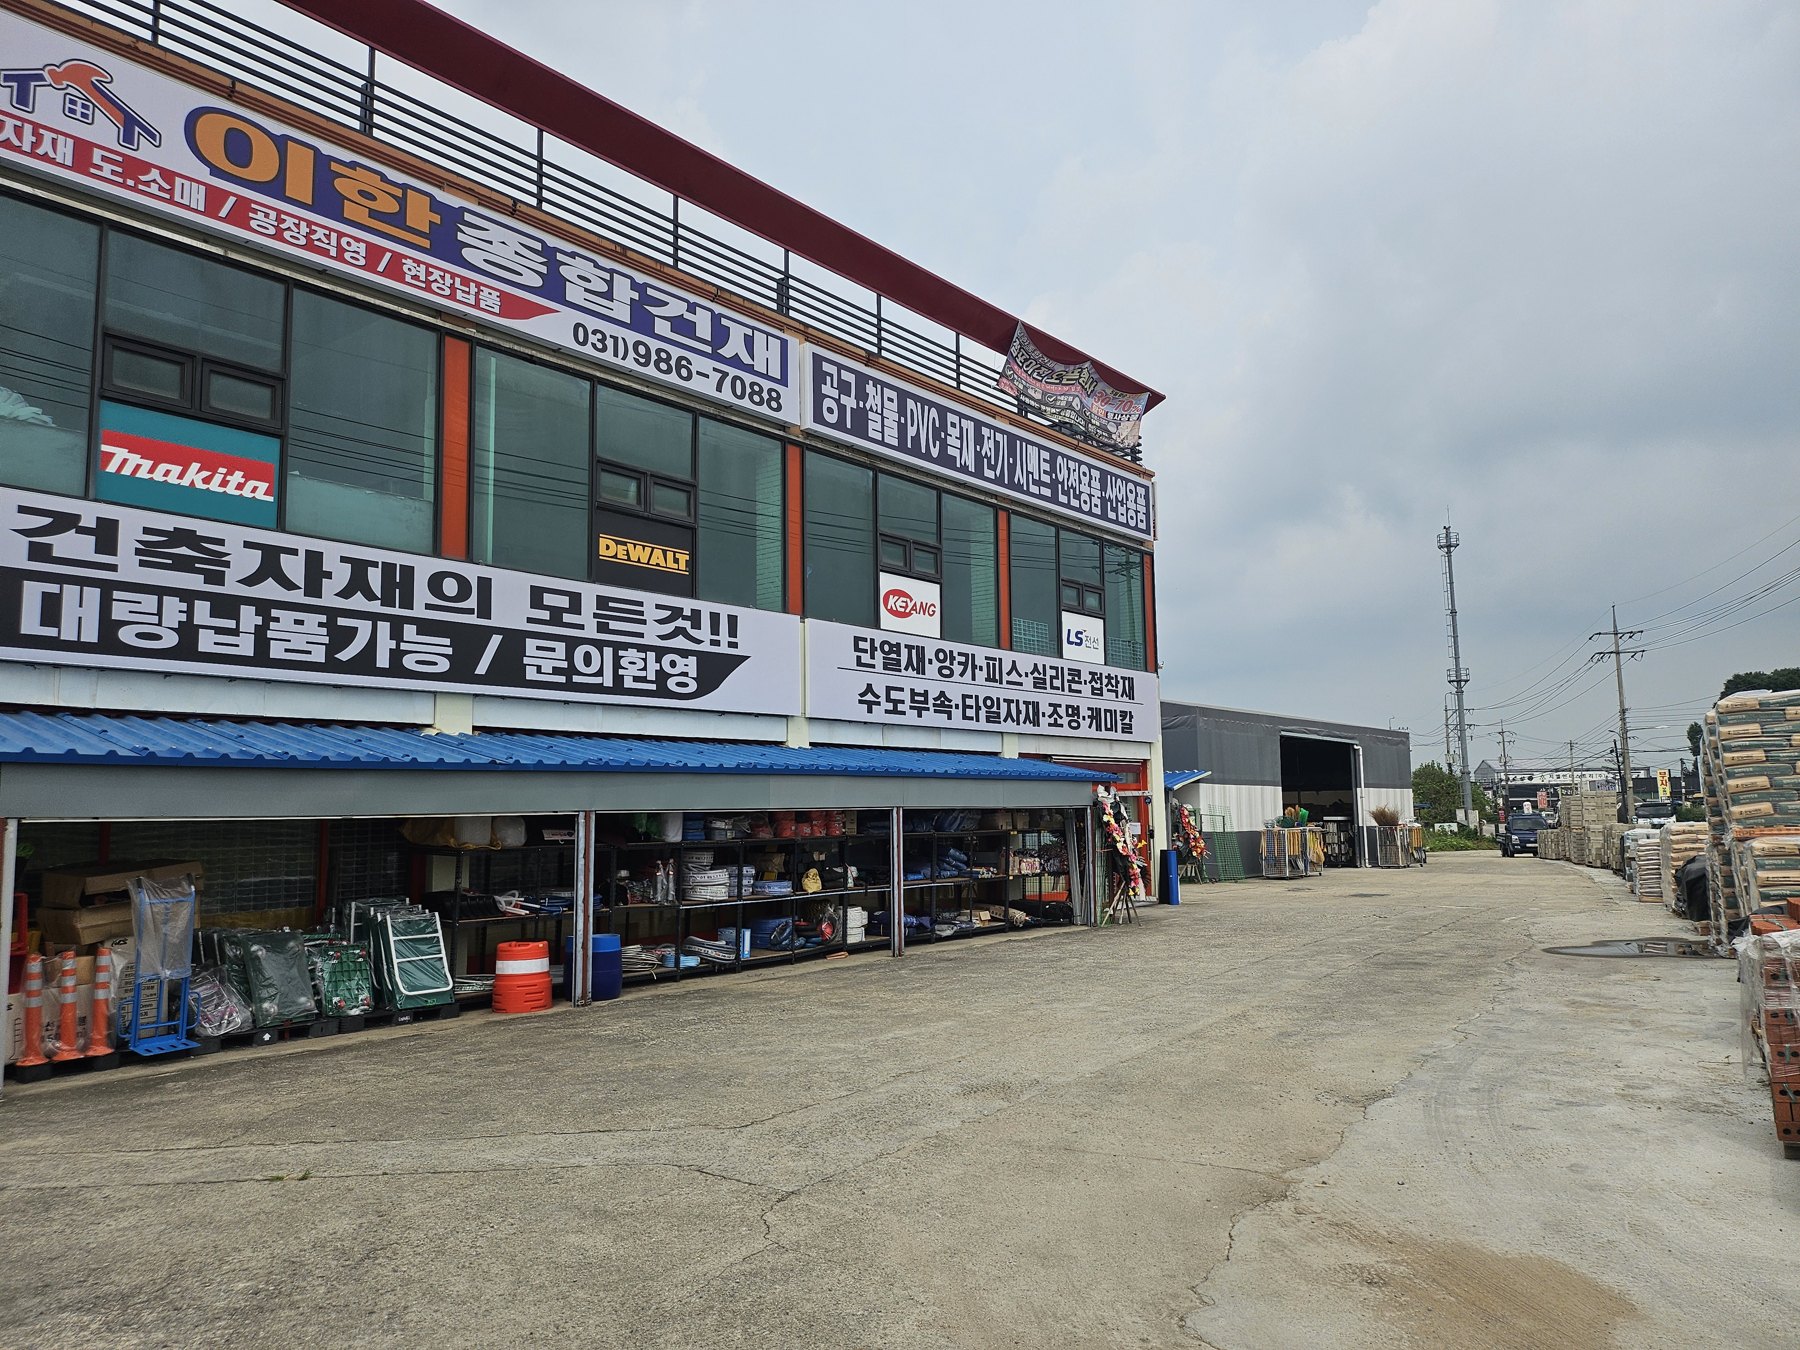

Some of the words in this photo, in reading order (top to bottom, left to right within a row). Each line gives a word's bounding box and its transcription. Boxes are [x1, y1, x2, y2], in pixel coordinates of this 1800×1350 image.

[193, 112, 442, 249] 이한
[456, 211, 783, 381] 종합건재
[248, 200, 368, 267] 공장직영
[401, 257, 502, 314] 현장납품
[572, 321, 784, 413] 031)986-7088
[9, 504, 493, 620] 건축자재의
[526, 584, 739, 649] 모든것!!
[886, 593, 937, 618] KEYANG
[19, 580, 453, 673] 대량납품가능
[523, 637, 698, 694] 문의환영
